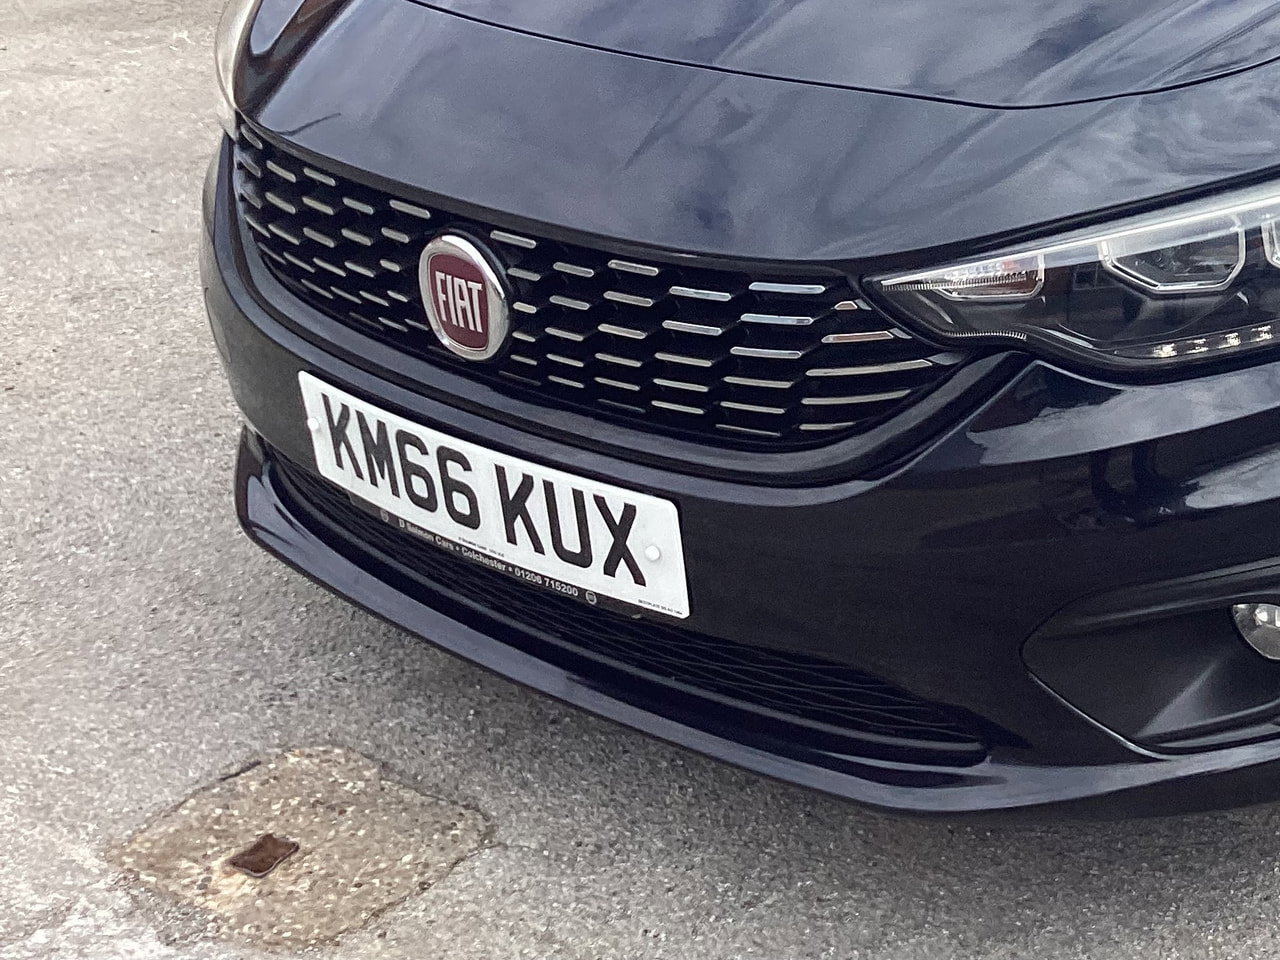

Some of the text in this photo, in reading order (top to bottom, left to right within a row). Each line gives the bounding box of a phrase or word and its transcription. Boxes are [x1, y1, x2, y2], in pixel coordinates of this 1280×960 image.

[435, 270, 483, 333] FIAT
[321, 393, 647, 588] KM66 KUX
[461, 546, 506, 571] Colchester
[544, 577, 579, 596] 715200
